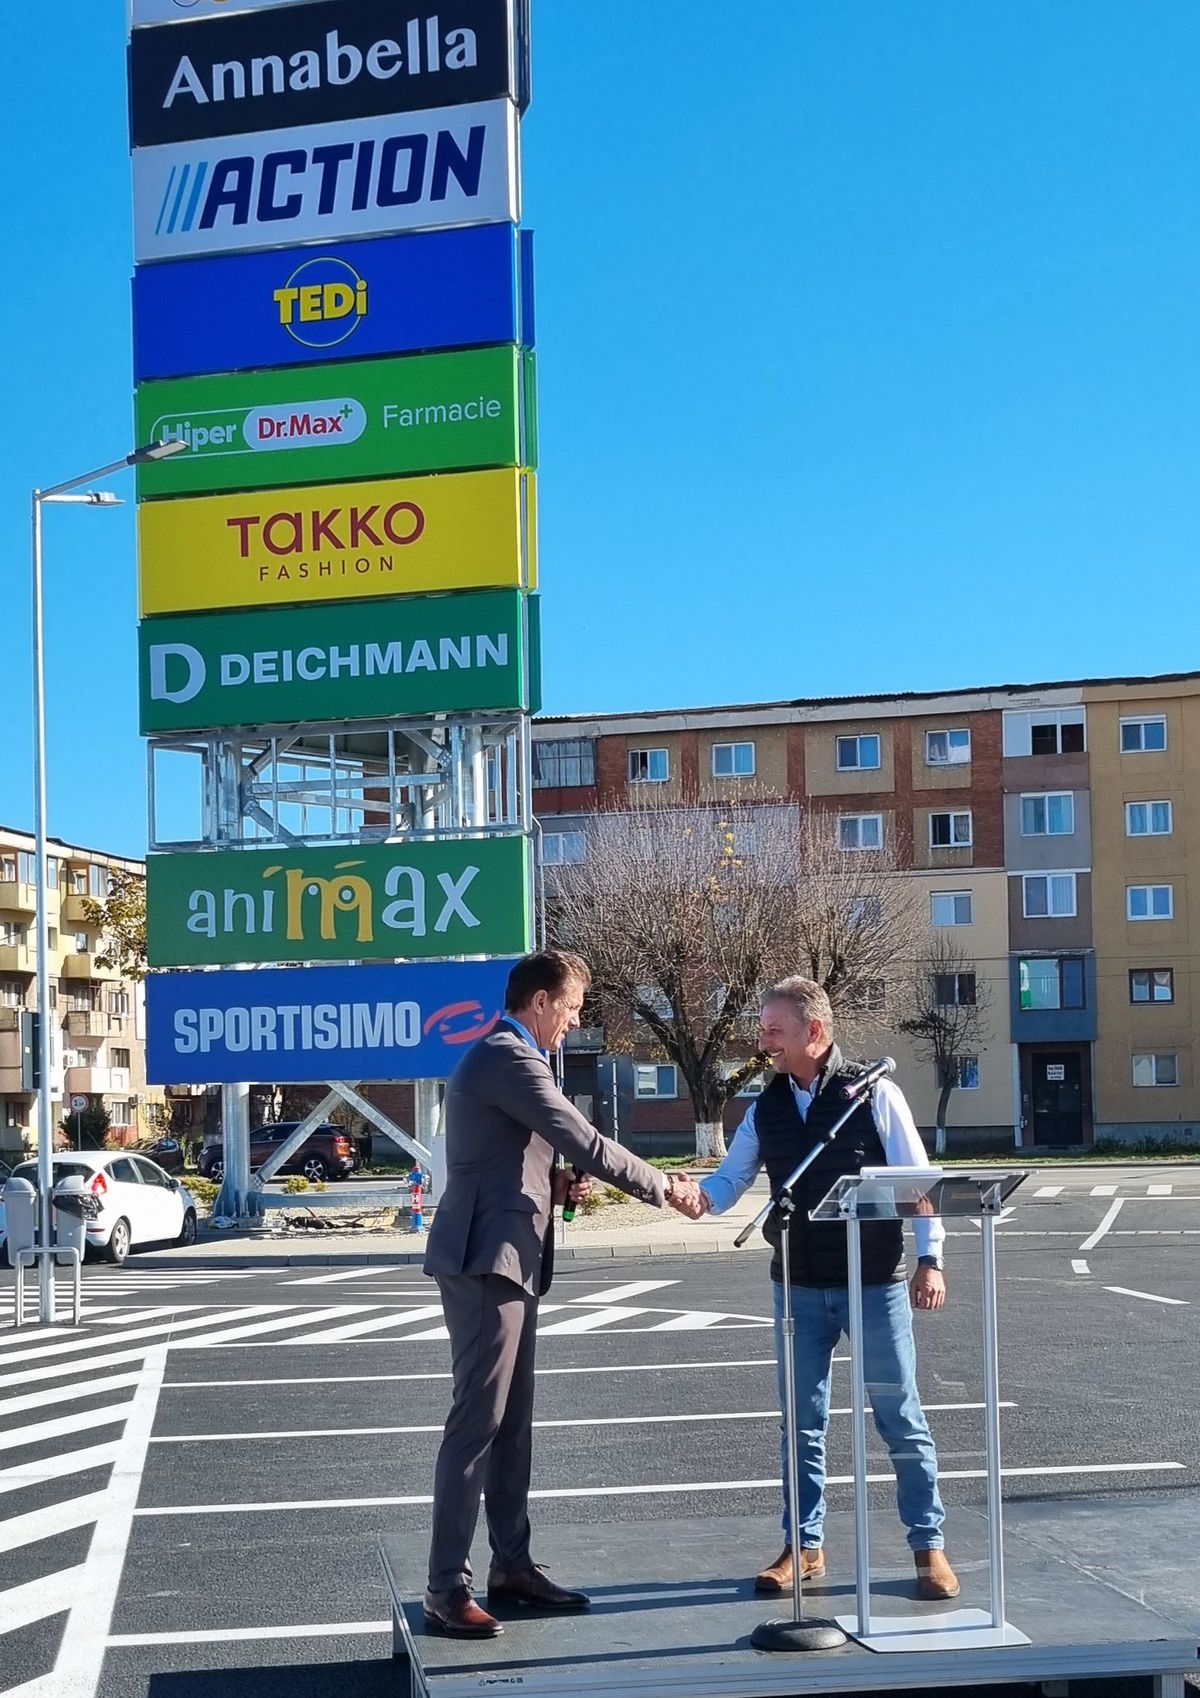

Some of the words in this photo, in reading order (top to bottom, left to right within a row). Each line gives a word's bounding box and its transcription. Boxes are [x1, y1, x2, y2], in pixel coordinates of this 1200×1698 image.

[162, 15, 478, 108] Annabella
[199, 125, 486, 229] ACTION
[273, 280, 368, 325] TEDi
[162, 421, 237, 452] Hiper
[383, 396, 502, 428] Farmacie
[259, 555, 395, 582] FASHION
[220, 633, 509, 687] DEICHMANN
[187, 860, 481, 943] animax
[174, 1001, 421, 1054] SPORTISIMO
